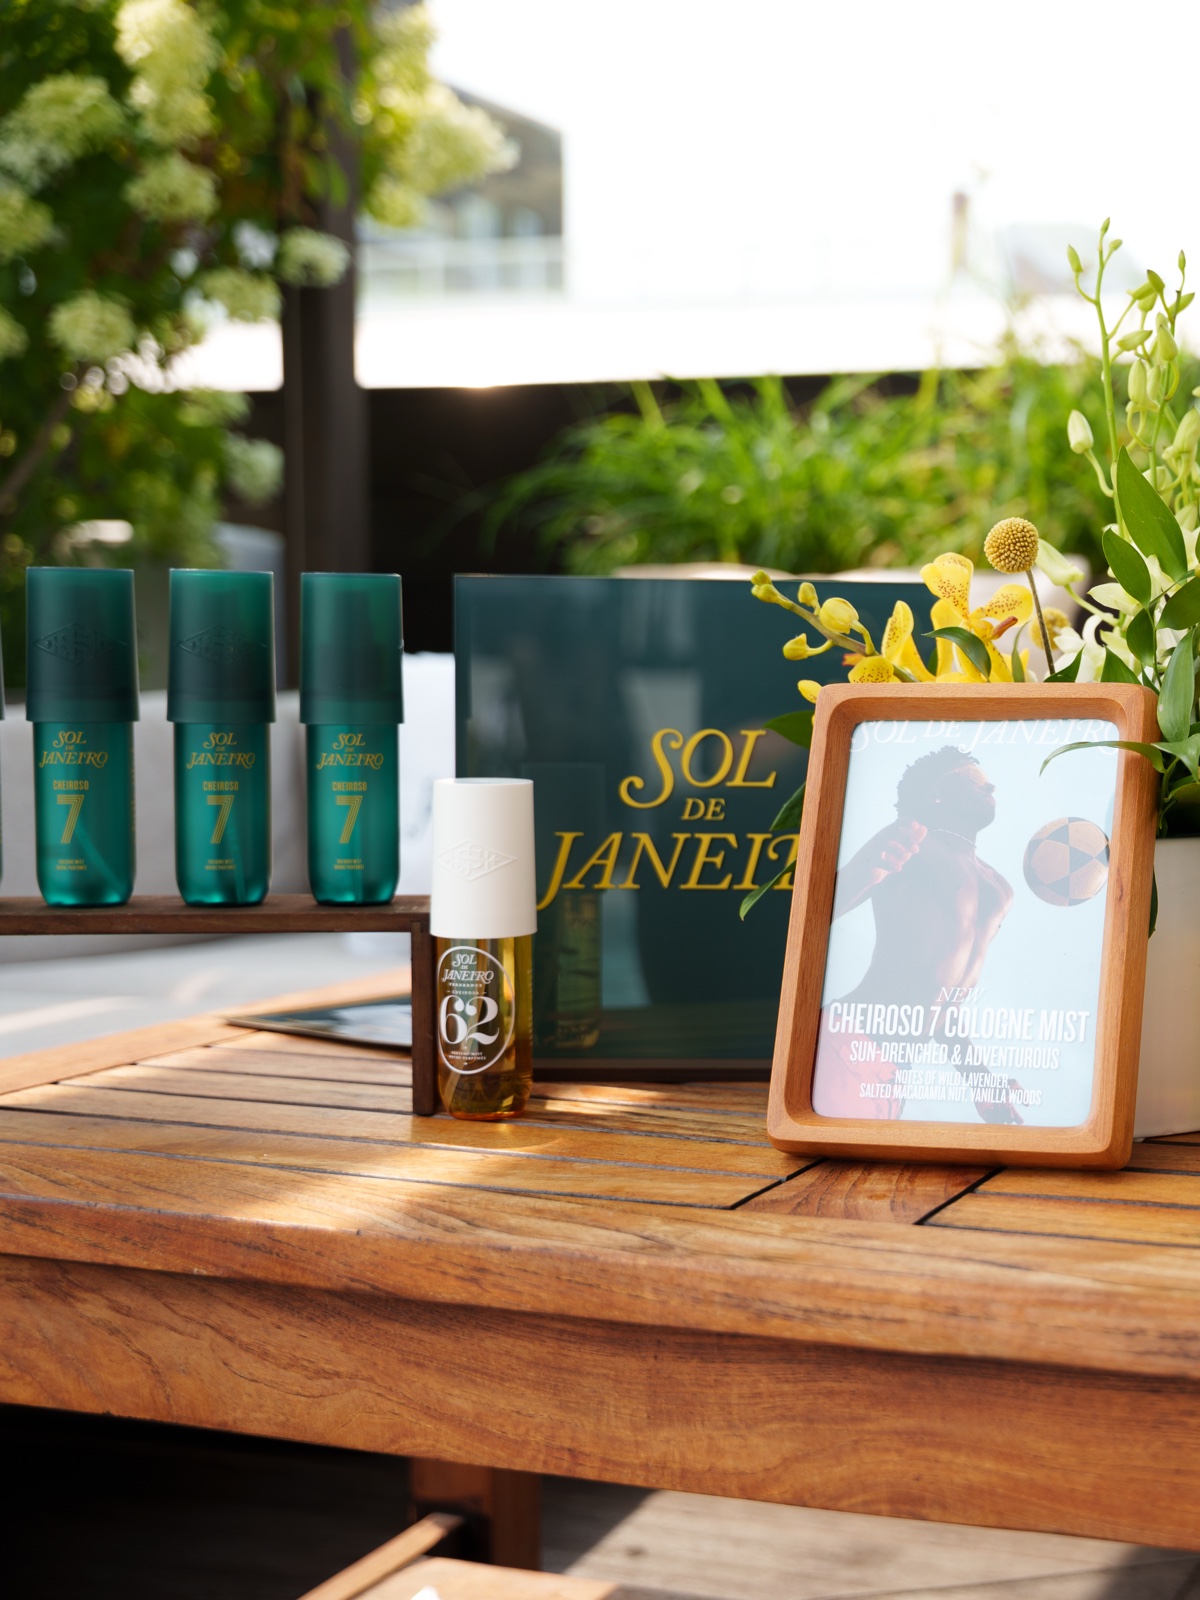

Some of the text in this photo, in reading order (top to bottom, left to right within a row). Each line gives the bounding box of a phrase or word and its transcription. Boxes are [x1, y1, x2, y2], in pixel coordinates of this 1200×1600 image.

[53, 730, 87, 748] SOL
[203, 732, 237, 749] SOL
[332, 733, 366, 750] SOL
[39, 751, 109, 768] JANEIRO
[186, 752, 256, 769] JANEIRO
[316, 753, 384, 770] JANEIRO
[619, 728, 777, 809] SOL
[53, 780, 89, 790] CHEIROSO
[203, 781, 239, 791] CHEIROSO
[332, 782, 367, 791] CHEIROSO
[681, 798, 726, 821] DE
[57, 794, 84, 844] 7
[207, 795, 235, 844] 7
[335, 795, 363, 844] 7
[452, 953, 477, 967] SOL
[442, 969, 494, 984] JANEIRO
[935, 986, 986, 1003] NEW
[440, 994, 500, 1045] 62
[828, 1002, 1090, 1043] CHEIROSO 7 COLOGNE MIST
[849, 1040, 1060, 1070] SUN-DRENCHED & ADVENTUROUS
[894, 1069, 1010, 1090] NOTES OF WILD LAVENDER,
[859, 1082, 892, 1099] SALTED
[893, 1084, 946, 1101] MACADAMIA
[969, 1088, 1006, 1103] VANILLA
[1007, 1089, 1042, 1105] WOODS
